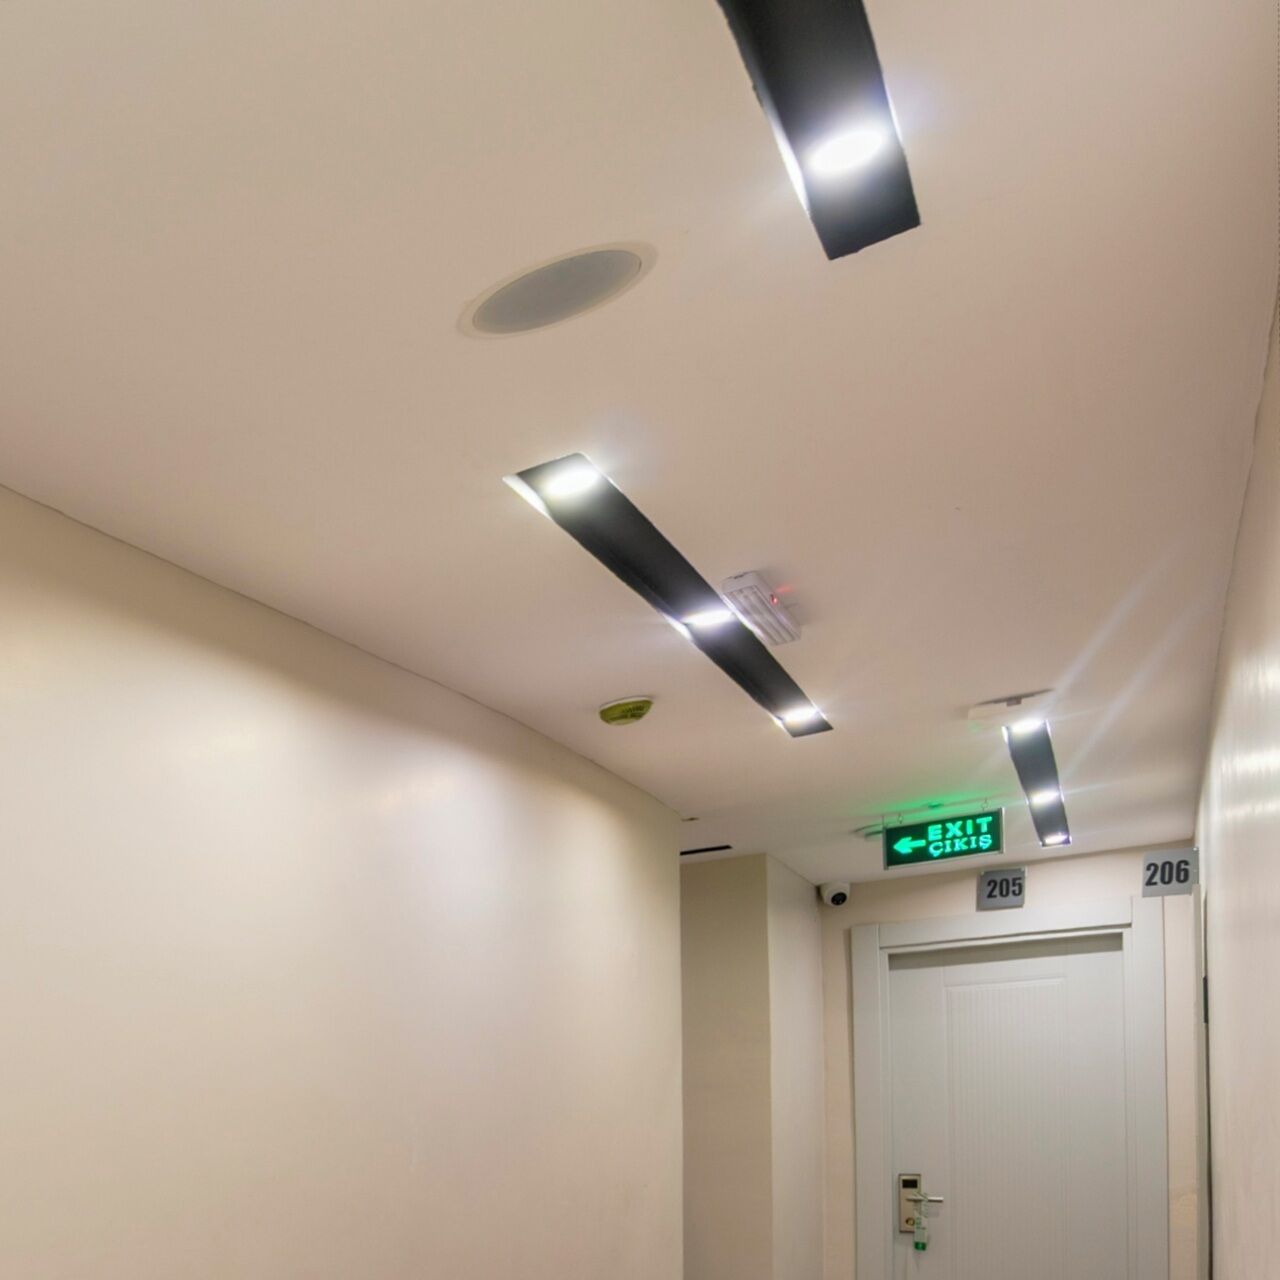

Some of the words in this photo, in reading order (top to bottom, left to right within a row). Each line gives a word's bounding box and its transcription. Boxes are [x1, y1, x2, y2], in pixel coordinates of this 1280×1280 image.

[928, 816, 993, 841] EXIT
[928, 834, 992, 857] ÇIKIŞ
[1145, 860, 1190, 886] 206
[987, 877, 1023, 898] 205
